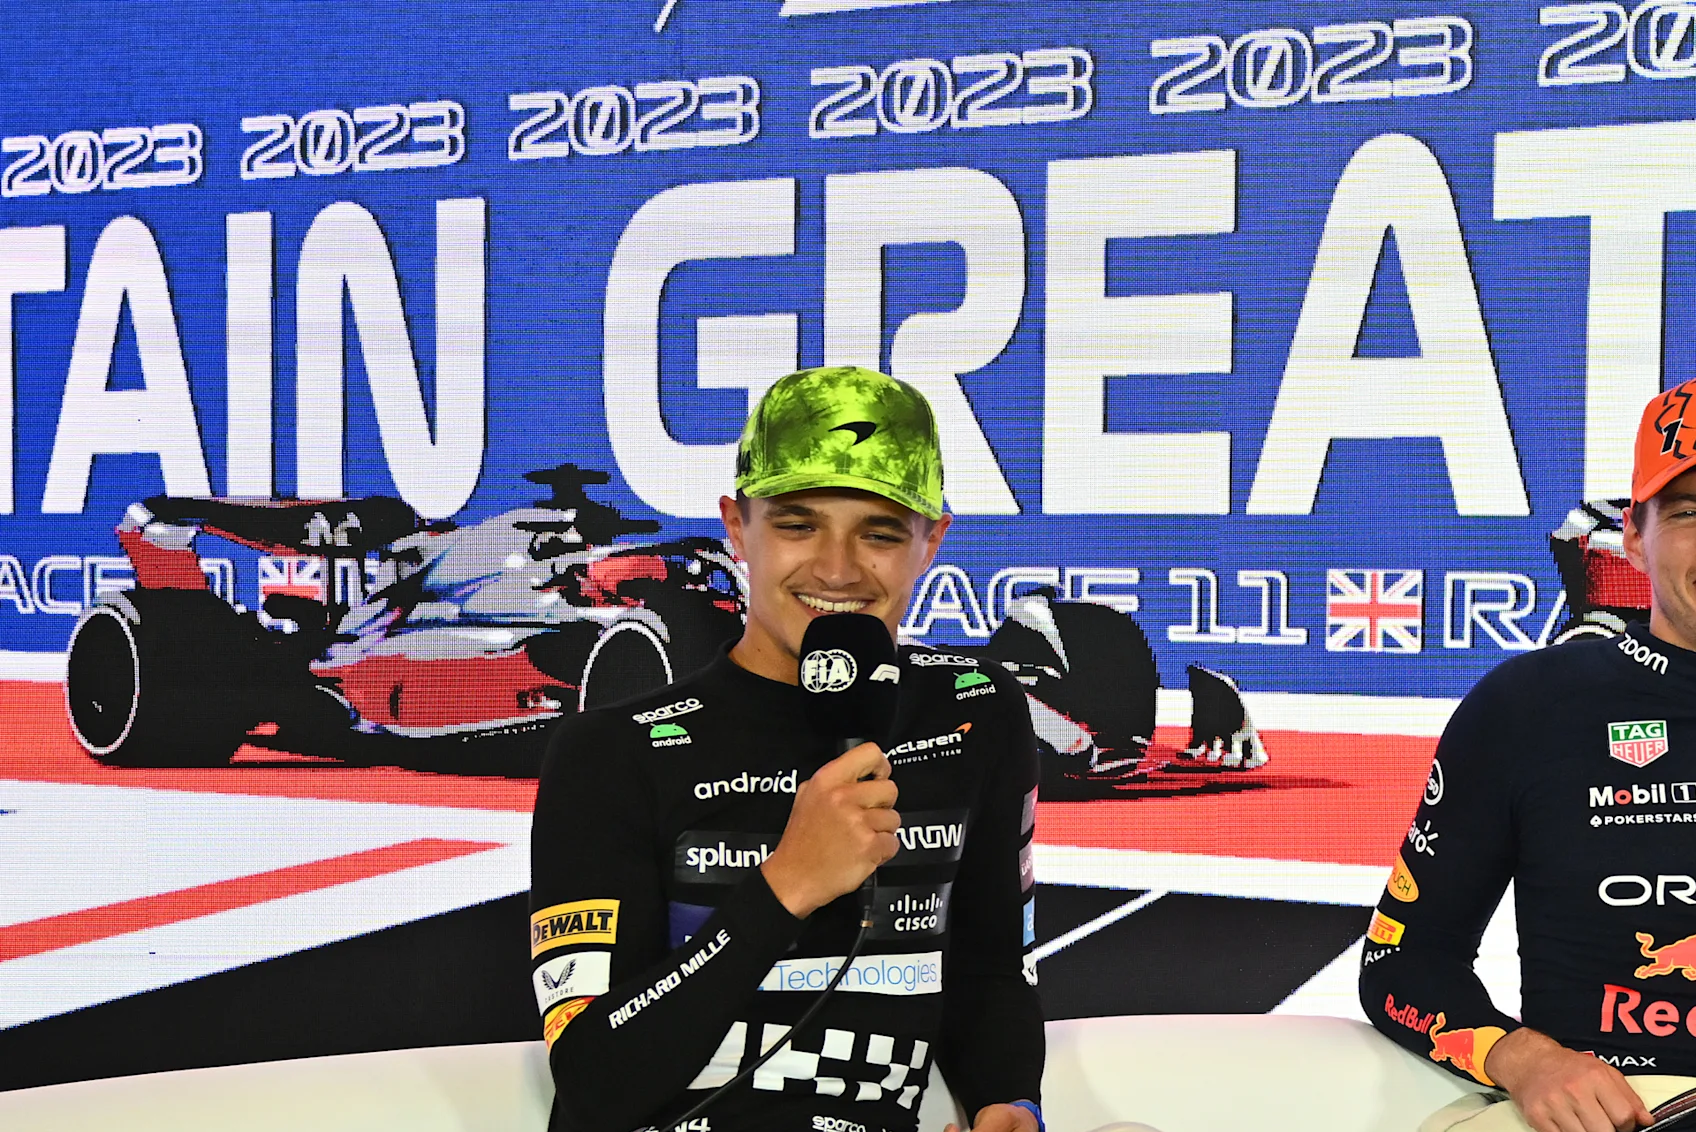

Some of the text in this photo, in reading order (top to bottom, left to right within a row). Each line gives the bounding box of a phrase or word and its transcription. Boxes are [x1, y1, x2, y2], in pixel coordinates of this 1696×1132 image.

[1, 124, 202, 196] 2023
[239, 100, 466, 180] 2023
[508, 76, 760, 161] 2023
[809, 47, 1093, 138] 2023
[1149, 15, 1473, 115] 2023
[1168, 568, 1308, 646] 11
[909, 652, 979, 667] sparco
[1617, 632, 1669, 675] zoom
[956, 684, 996, 700] android
[632, 697, 703, 724] sparco
[652, 735, 692, 748] android
[1614, 724, 1662, 739] TAG
[941, 748, 961, 758] TEAM
[1614, 741, 1664, 765] HEUER
[694, 769, 797, 799] android
[1589, 783, 1667, 808] Mobil
[608, 970, 682, 1029] RICHARD
[679, 928, 731, 978] MILLE
[1384, 993, 1436, 1035] Red Bull
[1599, 1054, 1657, 1068] MAX
